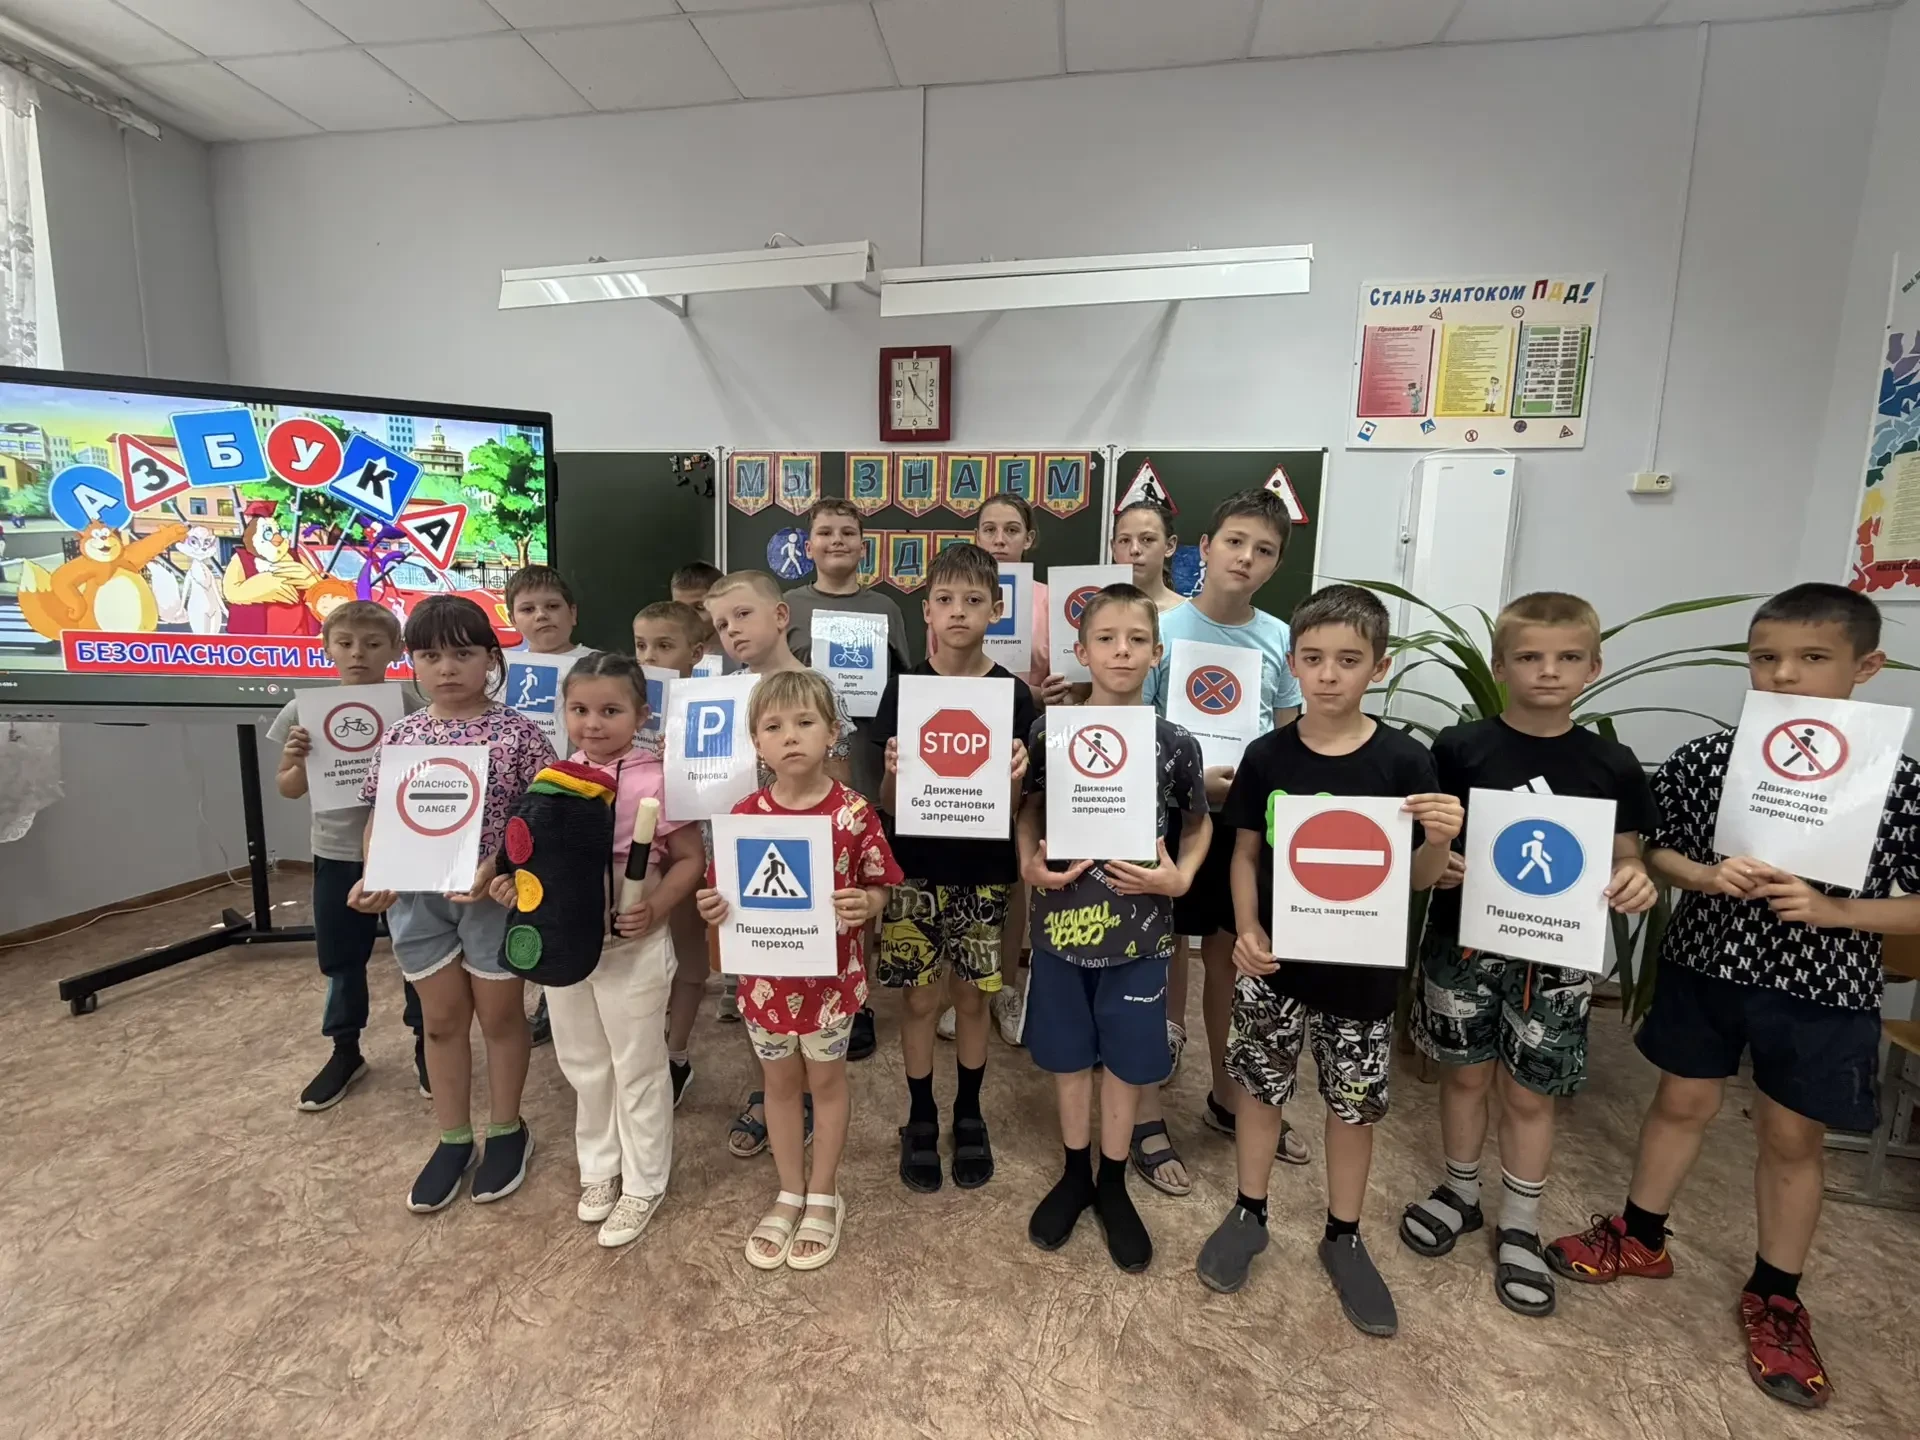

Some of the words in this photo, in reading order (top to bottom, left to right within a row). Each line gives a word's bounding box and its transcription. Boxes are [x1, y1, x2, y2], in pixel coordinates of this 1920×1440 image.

[1532, 279, 1596, 305] ПДД!
[898, 362, 904, 370] 11
[912, 362, 920, 370] 12
[895, 379, 903, 388] 10
[929, 379, 935, 387] 2
[896, 390, 902, 398] 9
[929, 390, 934, 398] 3
[896, 401, 901, 409] 8
[898, 418, 903, 426] 7
[912, 418, 918, 426] 6
[927, 418, 933, 426] 5
[736, 460, 811, 495] МЫ
[858, 460, 1081, 496] ЗНАЕМ
[77, 641, 299, 667] БЕЗОПАСНОСТИ
[838, 673, 864, 681] Полоса
[698, 705, 726, 752] P
[923, 731, 988, 755] STOP
[324, 770, 336, 778] на
[688, 771, 729, 781] Парковка
[411, 779, 469, 789] ОПАСНОСТЬ
[1073, 784, 1123, 794] Движение
[923, 784, 983, 797] Движение
[1756, 780, 1828, 802] Движение
[911, 797, 931, 808] без
[934, 798, 996, 810] остановки
[1071, 794, 1126, 804] пешеходов
[1751, 791, 1829, 815] пешеходов
[418, 804, 457, 813] DANGER
[1071, 805, 1126, 815] запрещено
[920, 811, 985, 823] запрещено
[1748, 803, 1825, 827] запрещено
[1290, 904, 1322, 916] Въезд
[1323, 906, 1378, 918] запрещен
[1486, 904, 1581, 931] Пешеходная
[736, 922, 819, 936] Пешеходный
[1498, 921, 1564, 943] дорожка
[751, 938, 805, 951] переход
[1080, 956, 1111, 968] ABOUT
